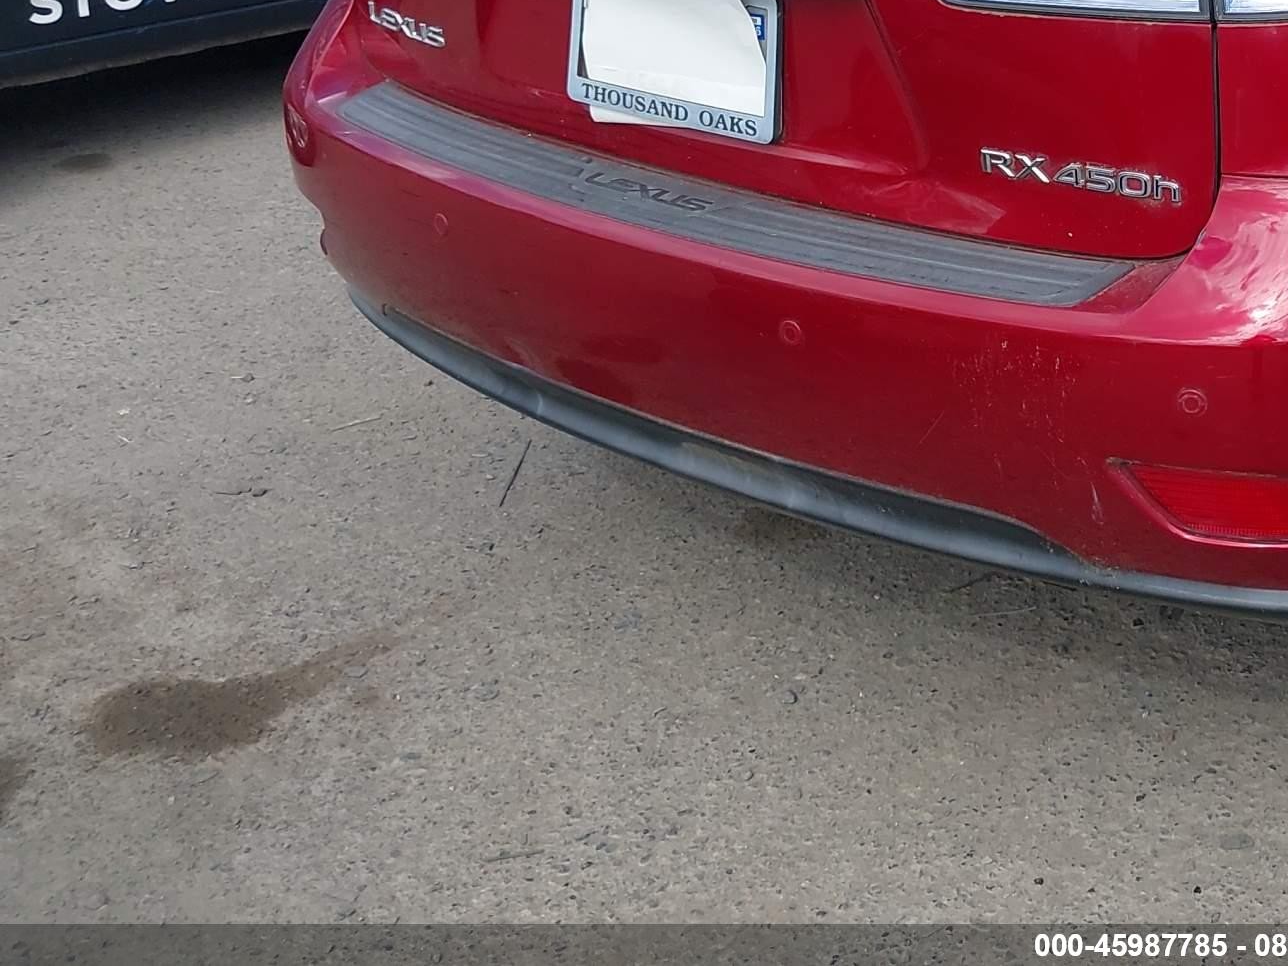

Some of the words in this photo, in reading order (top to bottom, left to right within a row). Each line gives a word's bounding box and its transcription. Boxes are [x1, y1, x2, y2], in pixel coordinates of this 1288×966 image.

[367, 0, 446, 47] LEXUS
[582, 83, 689, 122] THOUSAND
[699, 110, 758, 137] OAKS
[584, 172, 714, 212] LEXUS
[980, 147, 1050, 184] RX
[1053, 161, 1182, 203] 450h
